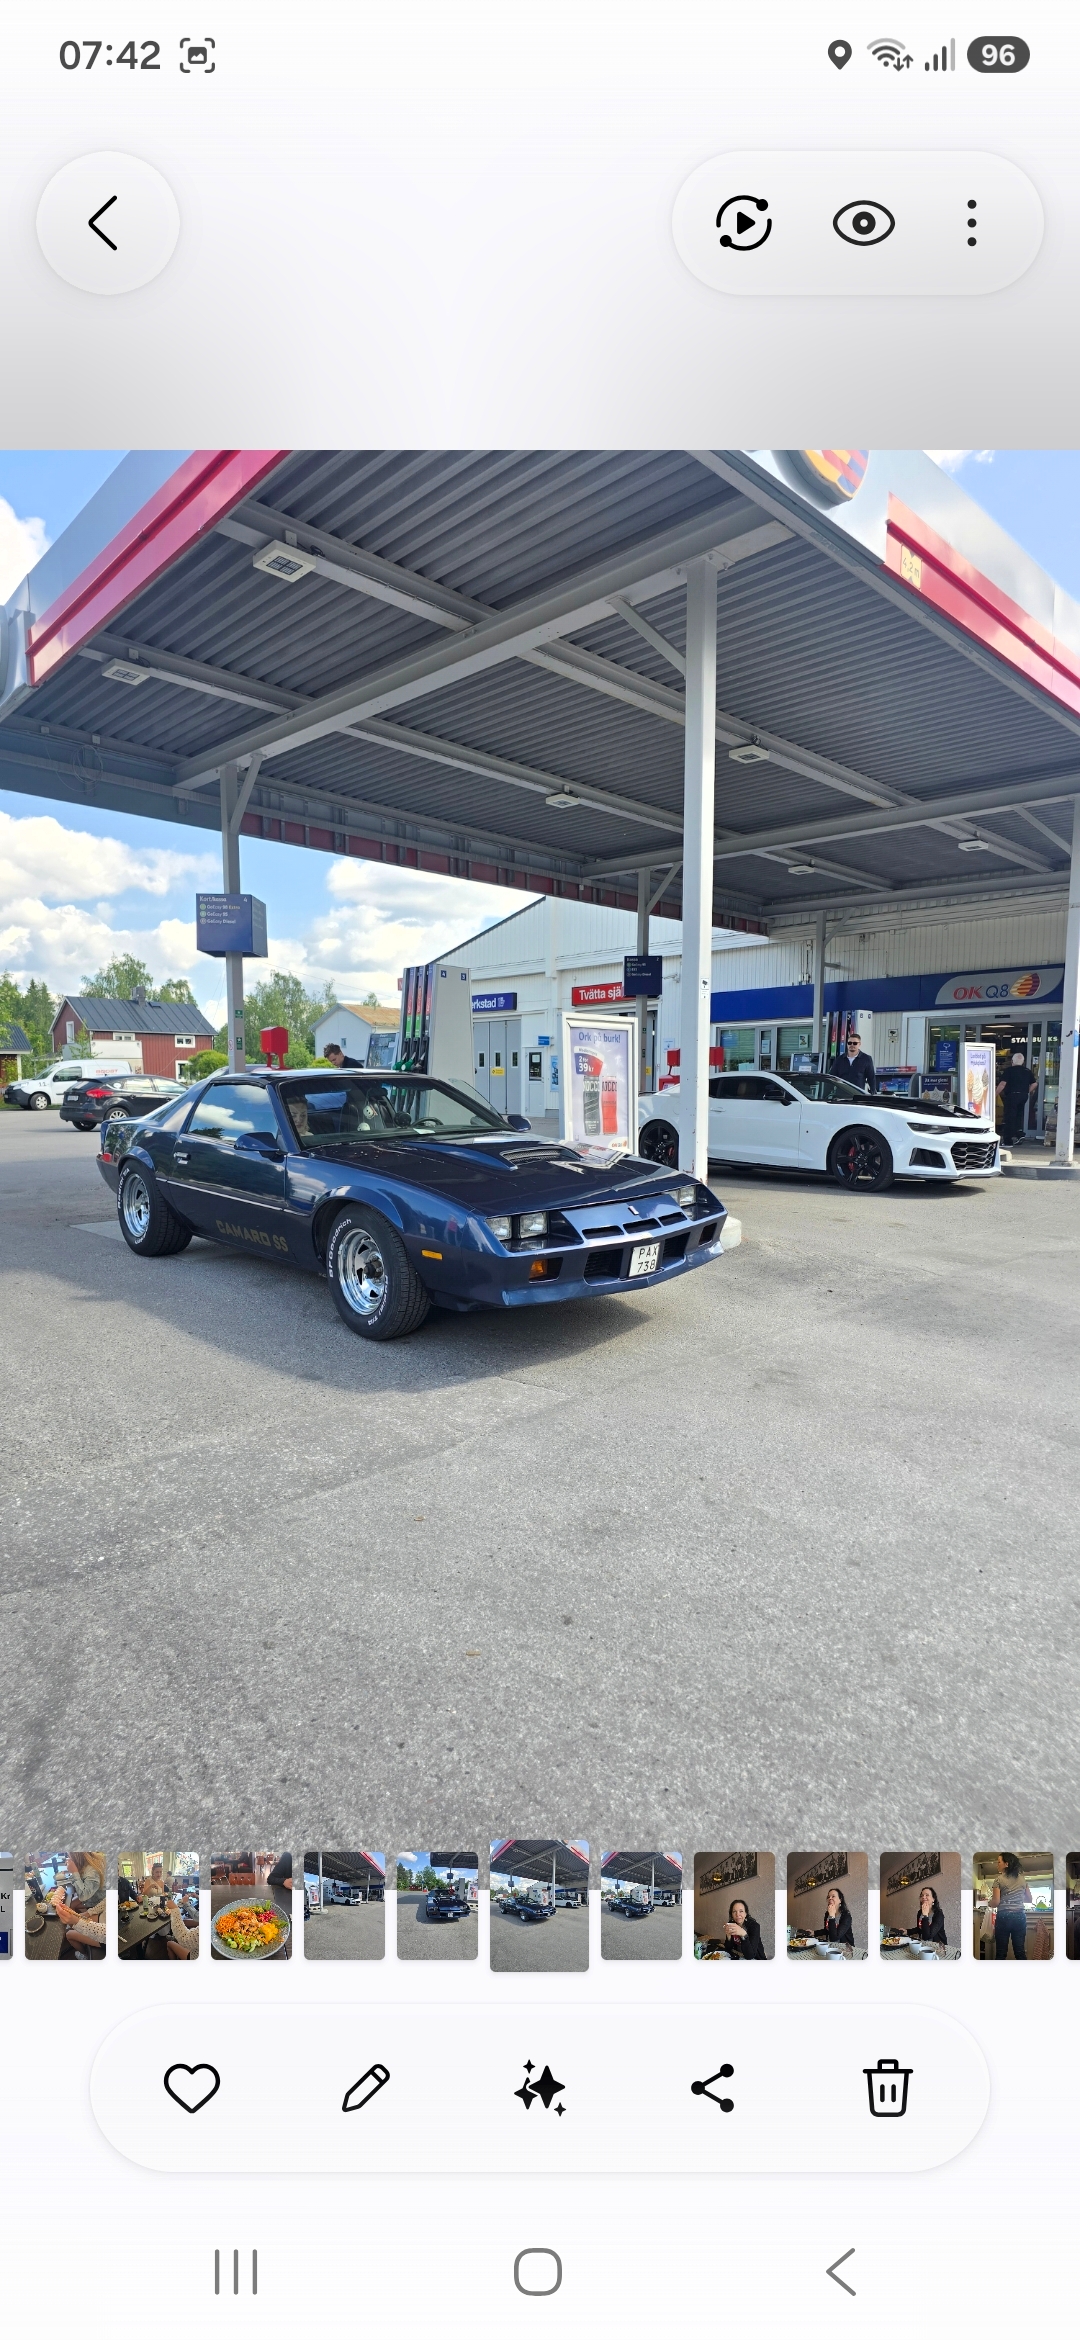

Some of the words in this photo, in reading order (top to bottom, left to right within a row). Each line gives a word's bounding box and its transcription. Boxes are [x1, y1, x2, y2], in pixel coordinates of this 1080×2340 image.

[579, 988, 606, 1001] Tvätta
[953, 986, 983, 1001] OK
[578, 1031, 592, 1041] Ork
[593, 1031, 602, 1044] på
[603, 1033, 621, 1043] burk!
[578, 1055, 583, 1063] 2
[578, 1063, 588, 1072] 39
[215, 1219, 272, 1247] CAMARO
[272, 1234, 289, 1252] SS
[328, 1218, 352, 1278] BFGoodrich
[638, 1245, 658, 1259] PAX
[637, 1258, 656, 1273] 738
